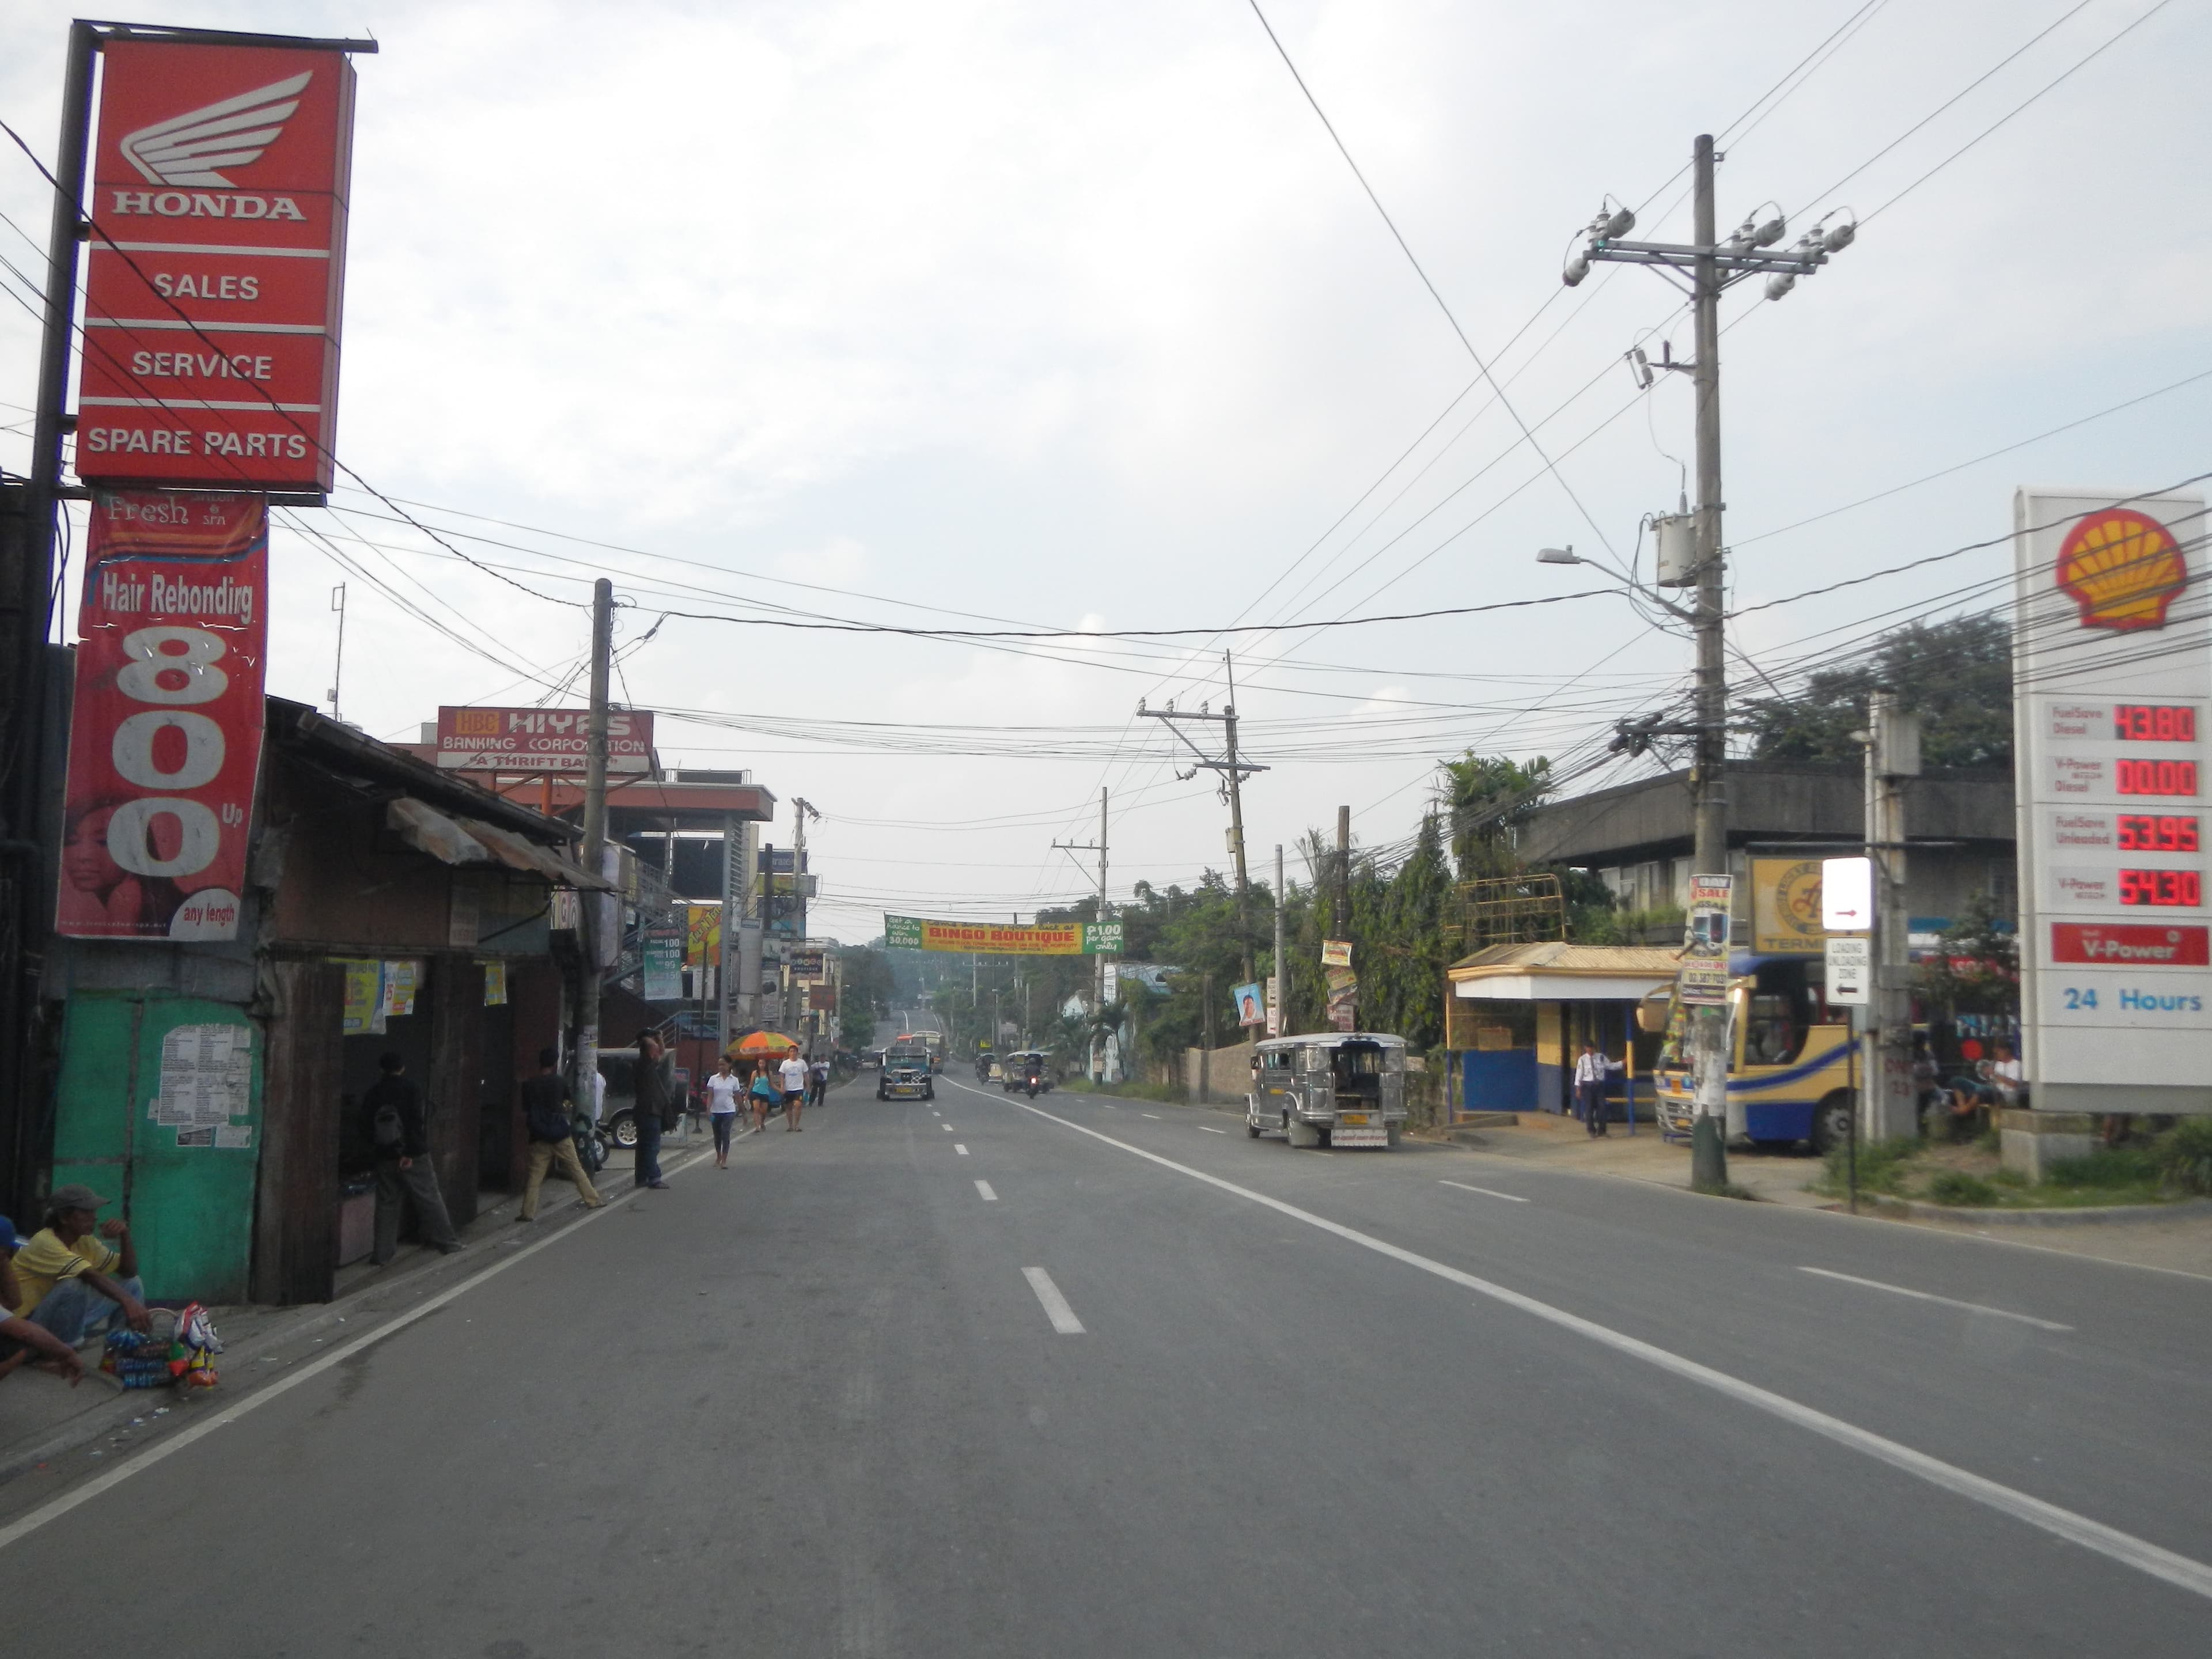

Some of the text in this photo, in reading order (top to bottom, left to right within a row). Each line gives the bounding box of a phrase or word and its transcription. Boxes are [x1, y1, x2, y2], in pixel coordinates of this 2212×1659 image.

[112, 191, 306, 221] HONDA
[154, 273, 259, 300] SALES
[132, 350, 272, 380] SERVICE
[88, 427, 306, 459] SPARE PARTS
[108, 496, 189, 524] Fresh
[103, 571, 253, 624] Hair Rebonding
[443, 736, 645, 752] BANKING CORPOTION
[494, 756, 557, 766] THRIFT
[222, 803, 243, 829] Up
[184, 904, 235, 926] any length
[664, 938, 680, 948] 100
[929, 927, 1074, 944] BINGO BOUTIQUE
[1086, 935, 1099, 945] per
[1096, 942, 1116, 951] only
[664, 949, 680, 959] 100
[2082, 940, 2176, 959] V-Power
[2063, 988, 2203, 1012] 24 Hours
